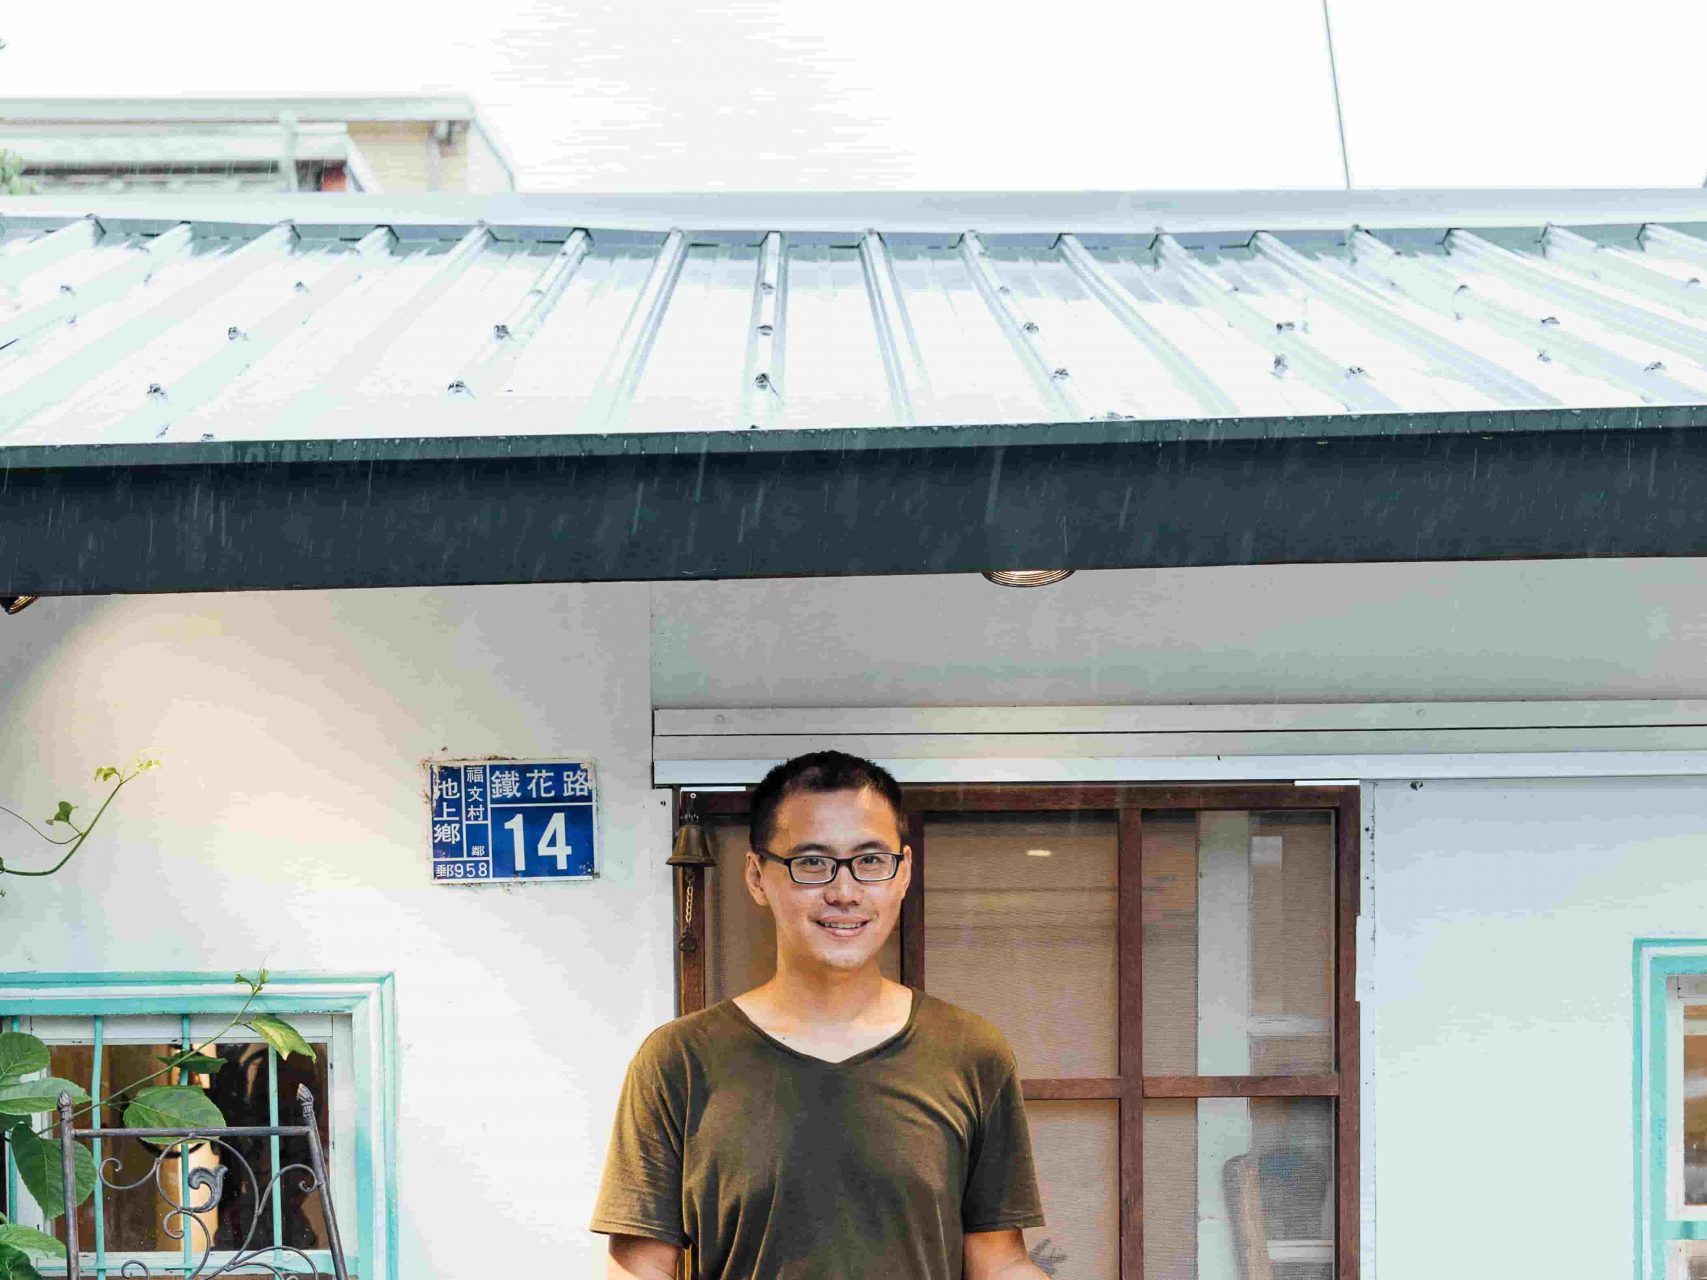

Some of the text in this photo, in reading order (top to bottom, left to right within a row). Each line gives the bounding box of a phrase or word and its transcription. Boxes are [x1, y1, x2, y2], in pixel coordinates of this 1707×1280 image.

[433, 777, 461, 845] 池上鄉
[466, 766, 485, 822] 福文村
[490, 769, 590, 799] 鐵花路
[503, 811, 573, 872] 14
[435, 862, 488, 878] 郵958
